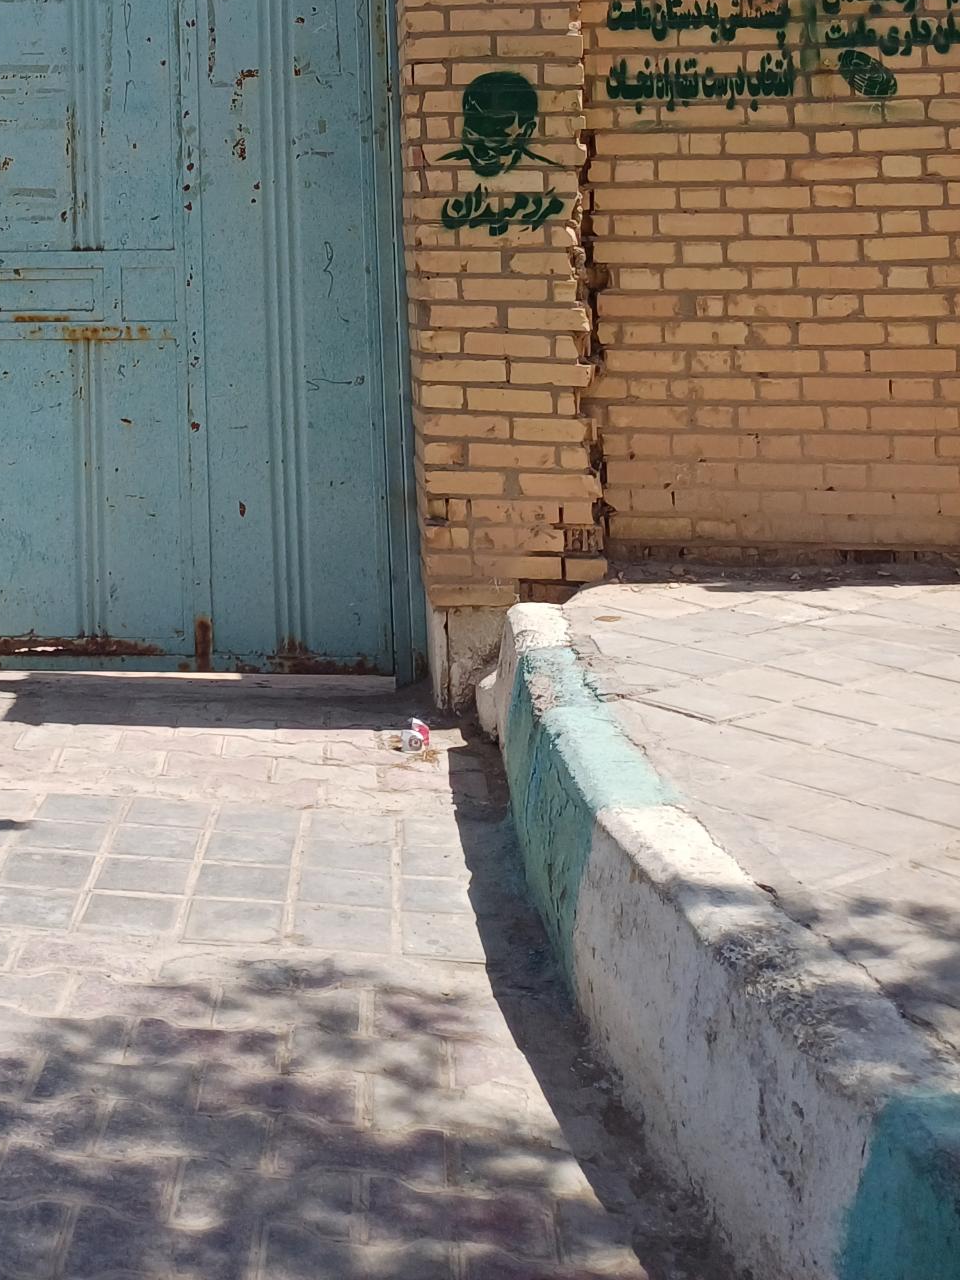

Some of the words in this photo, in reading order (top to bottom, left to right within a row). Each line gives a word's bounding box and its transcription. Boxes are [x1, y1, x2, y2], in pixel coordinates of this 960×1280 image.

[605, 53, 655, 115] نجات
[701, 63, 745, 111] درست
[747, 50, 794, 112] انتخاب
[441, 183, 529, 237] میدان
[519, 186, 565, 233] مرد
